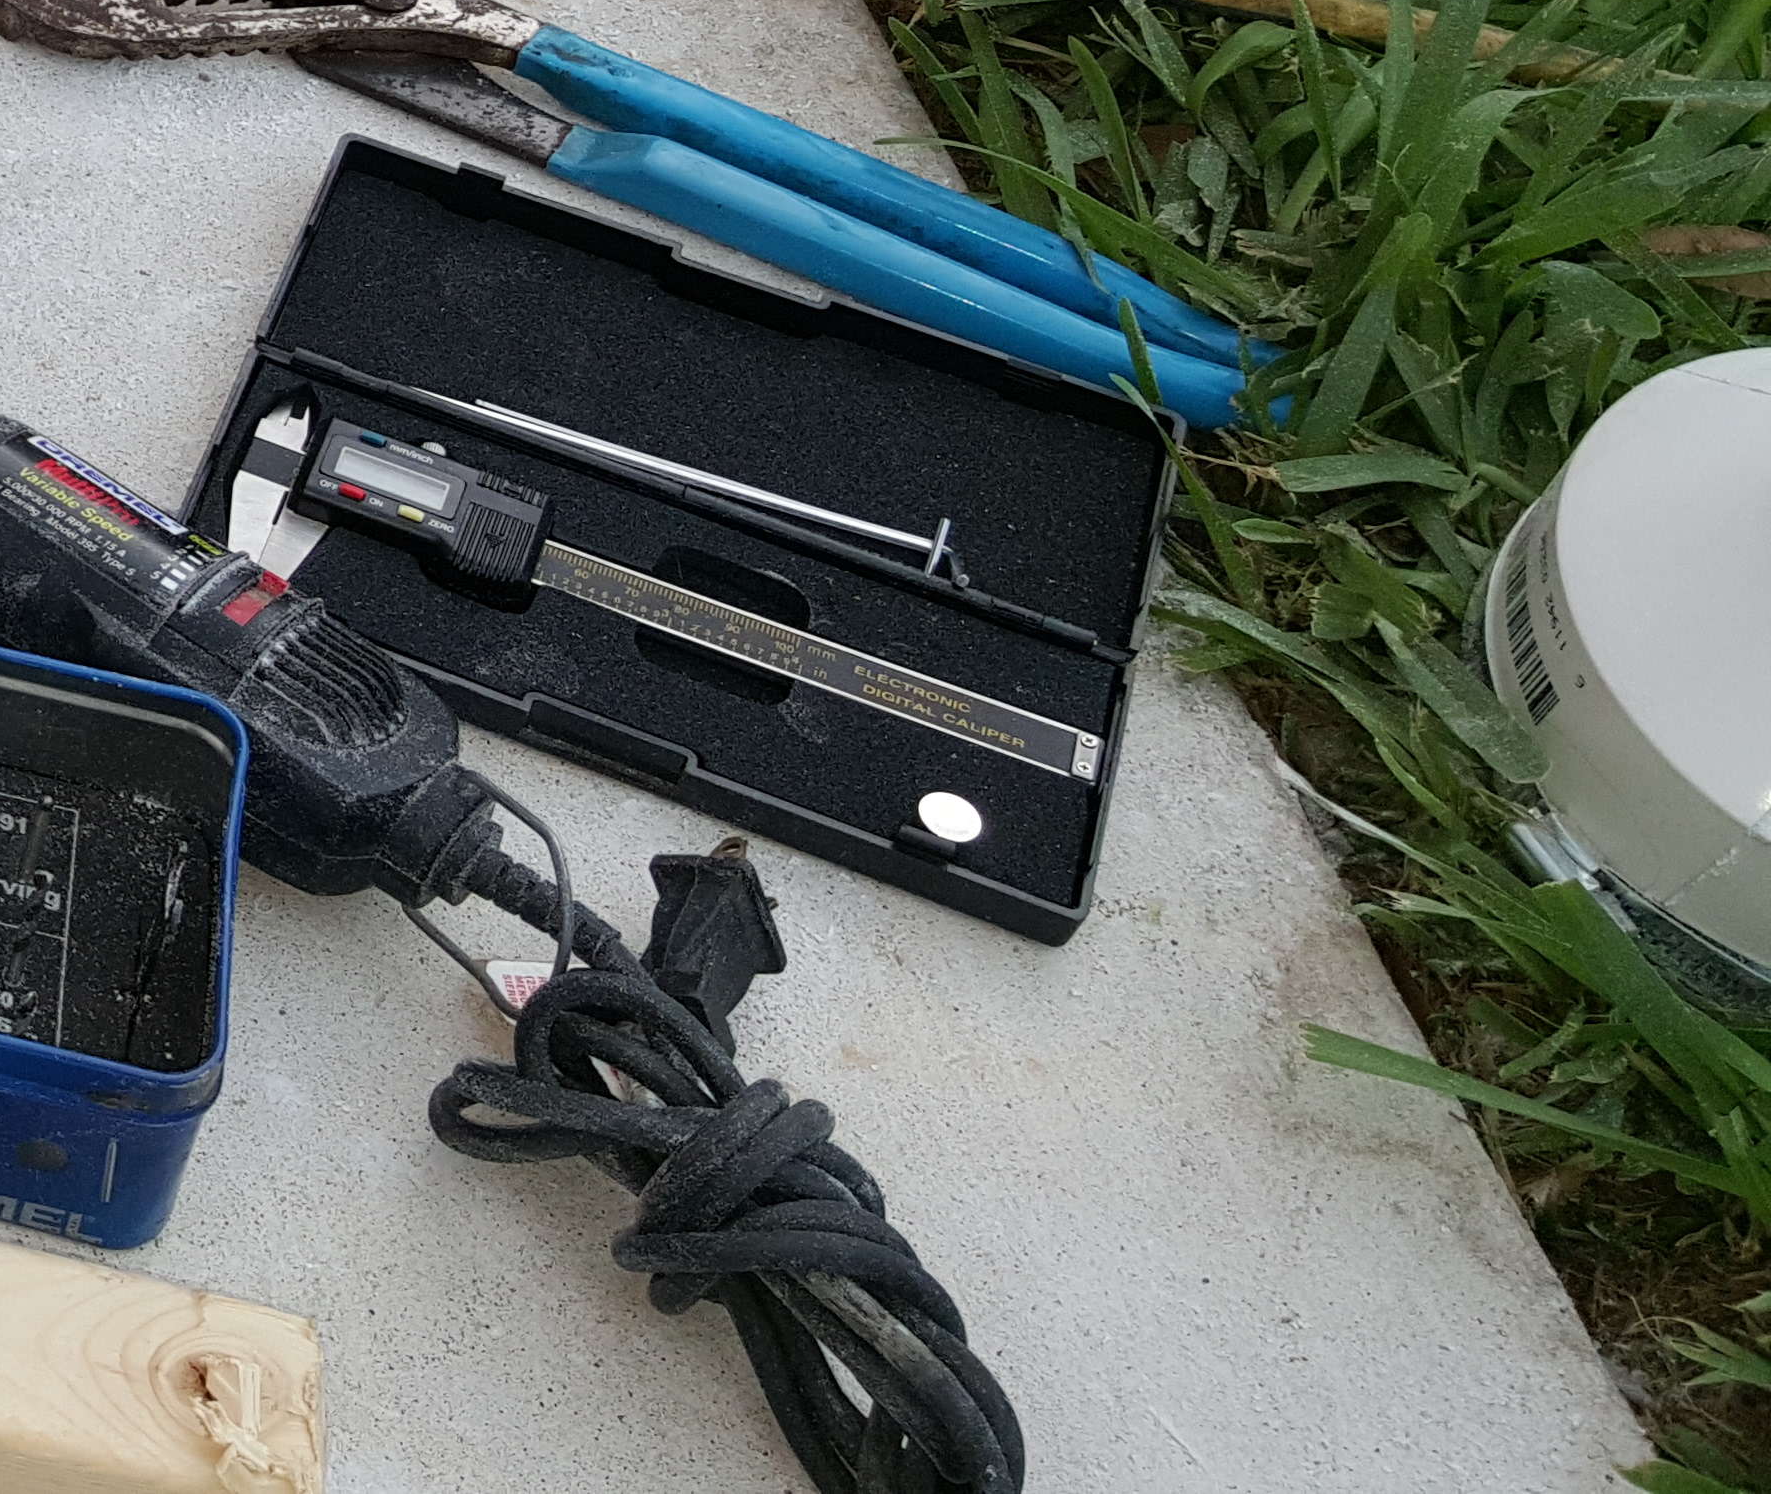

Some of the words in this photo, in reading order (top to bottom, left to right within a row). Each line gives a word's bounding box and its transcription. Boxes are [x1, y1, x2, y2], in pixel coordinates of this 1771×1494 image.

[389, 444, 434, 465] mm/inch
[1, 488, 41, 518] Bearing
[46, 517, 79, 544] Model
[77, 538, 99, 553] 395
[100, 553, 126, 572] Type
[20, 467, 80, 509] Variable
[81, 507, 134, 542] Speed
[319, 479, 338, 491] OFF
[369, 497, 384, 507] ON
[428, 518, 454, 533] ZERO
[624, 586, 640, 598] 70
[724, 622, 741, 635] 90
[807, 645, 838, 661] mm
[853, 665, 972, 713] ELECTRONIC
[862, 683, 938, 718] DIGITAL
[942, 713, 1026, 749] CALIPER
